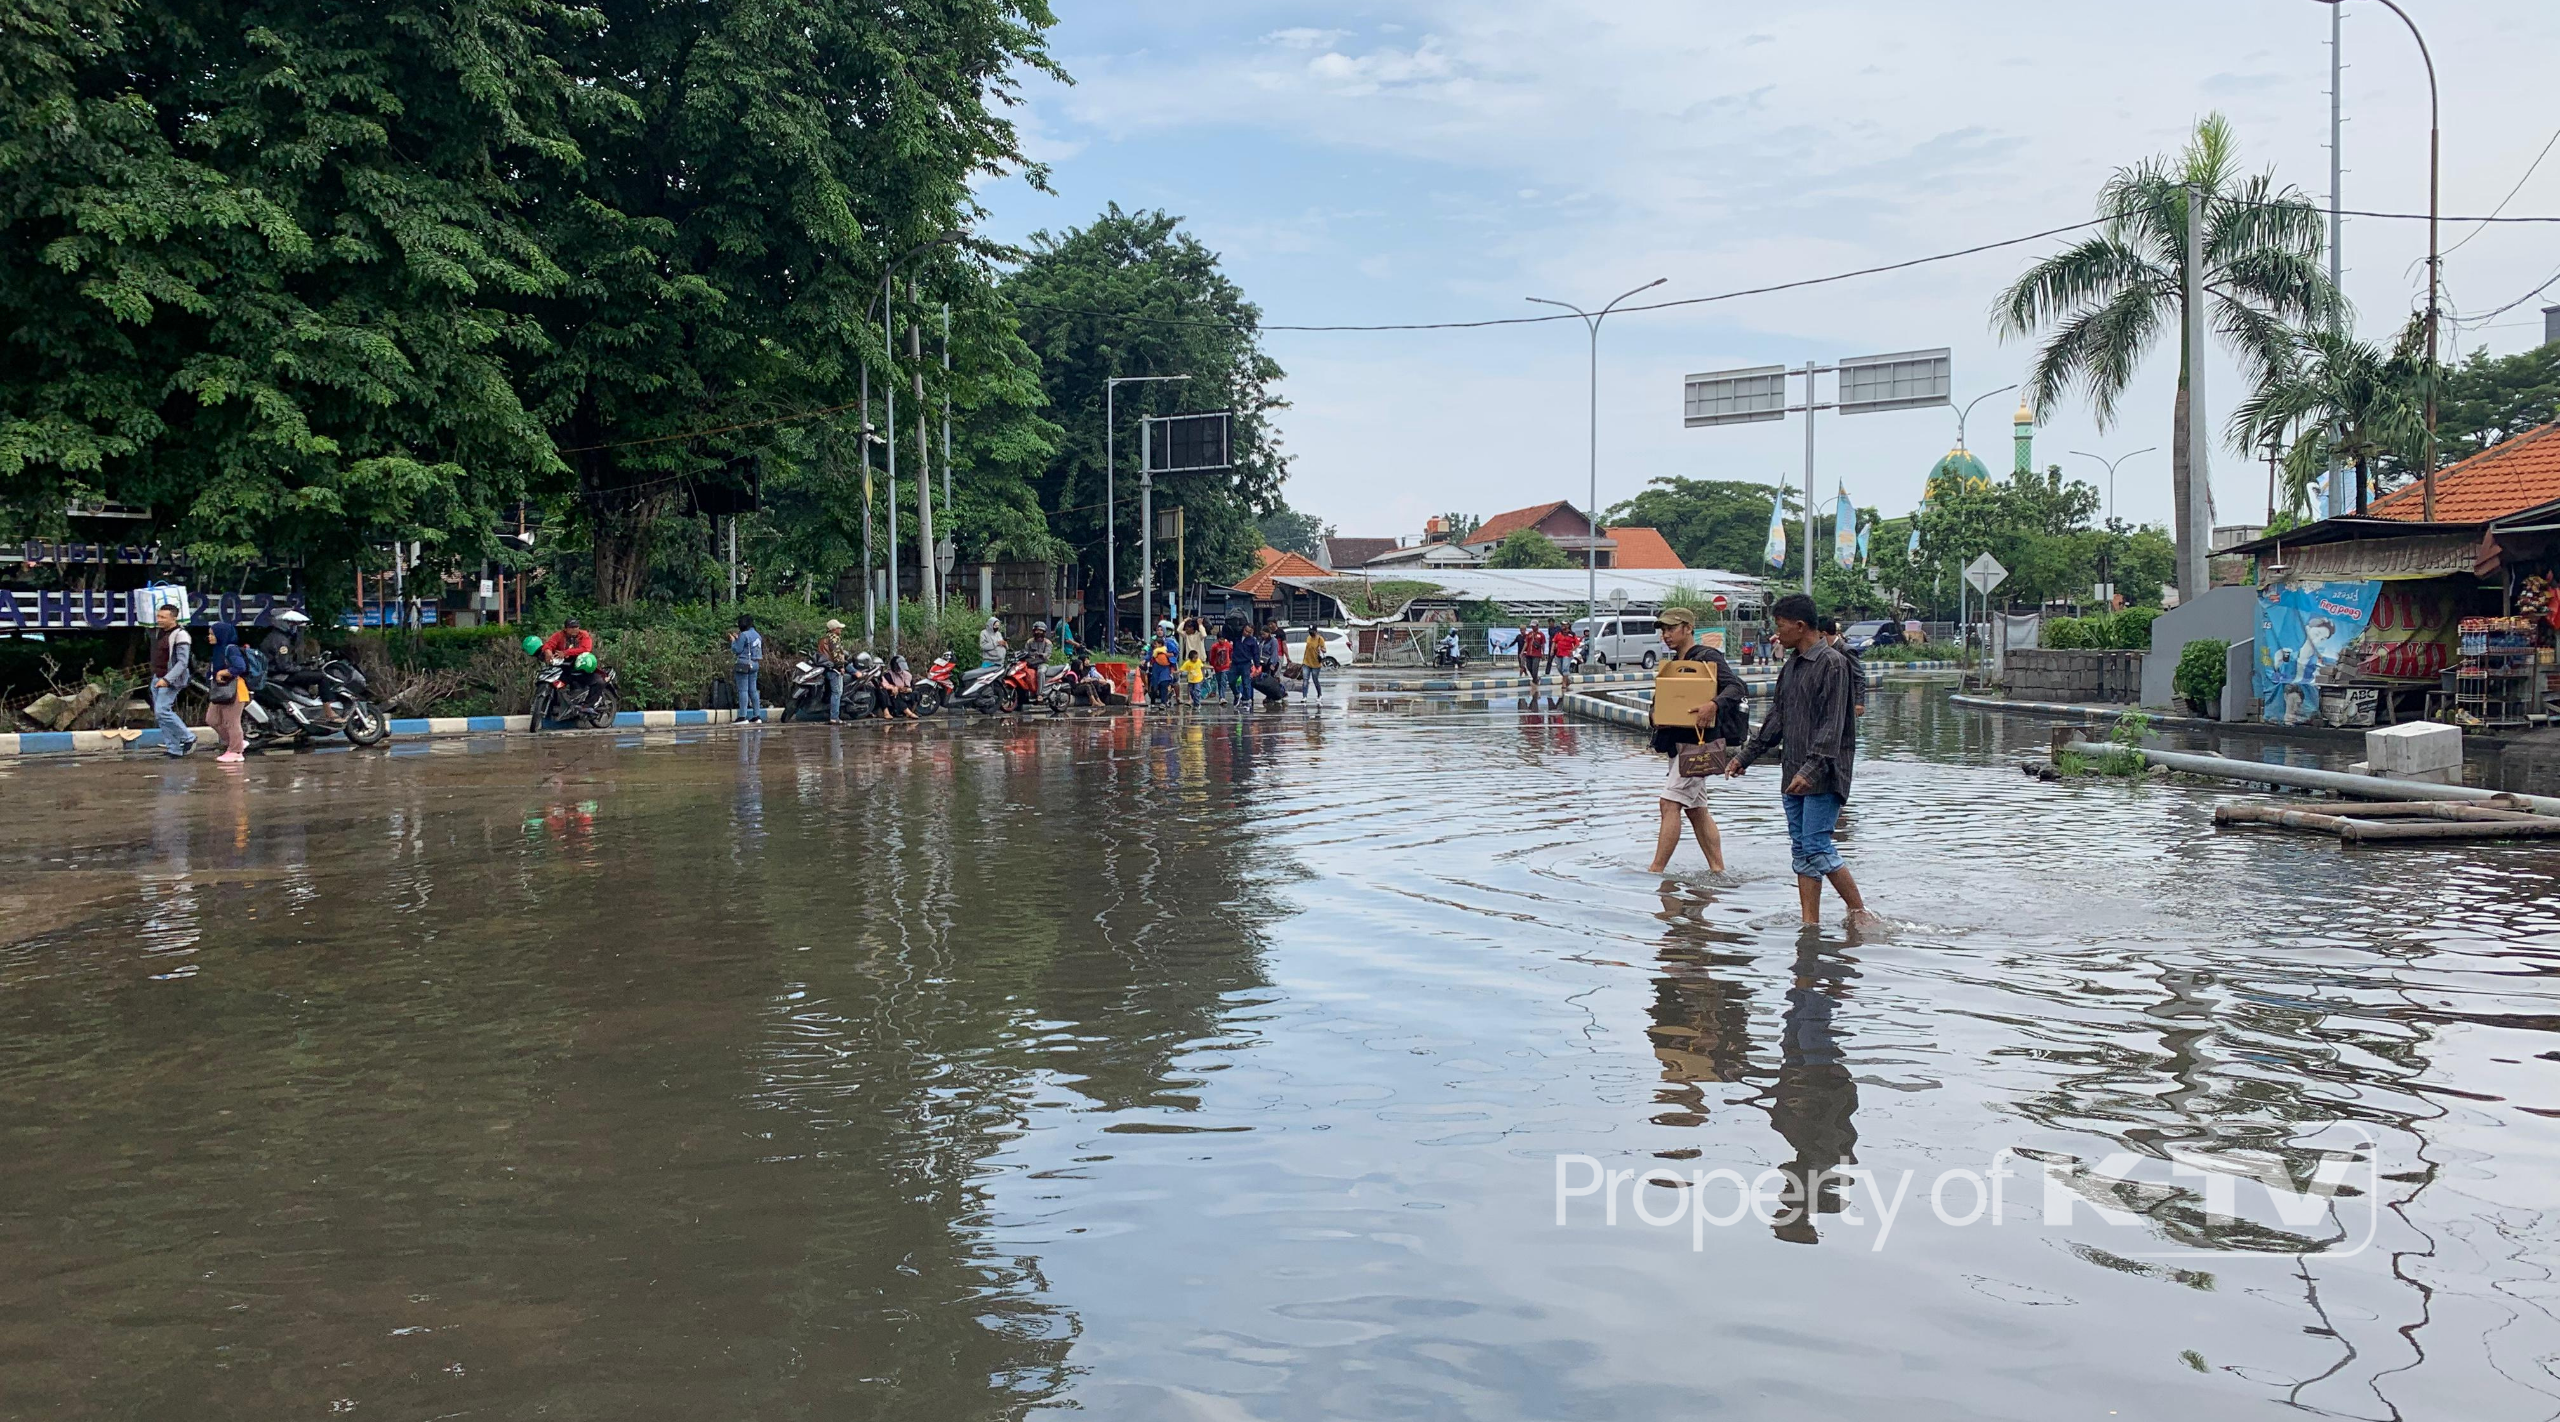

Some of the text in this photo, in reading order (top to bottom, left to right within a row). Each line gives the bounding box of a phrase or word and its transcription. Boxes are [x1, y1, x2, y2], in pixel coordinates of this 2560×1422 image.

[2319, 599, 2362, 620] Good Day
[2349, 688, 2376, 702] ABC
